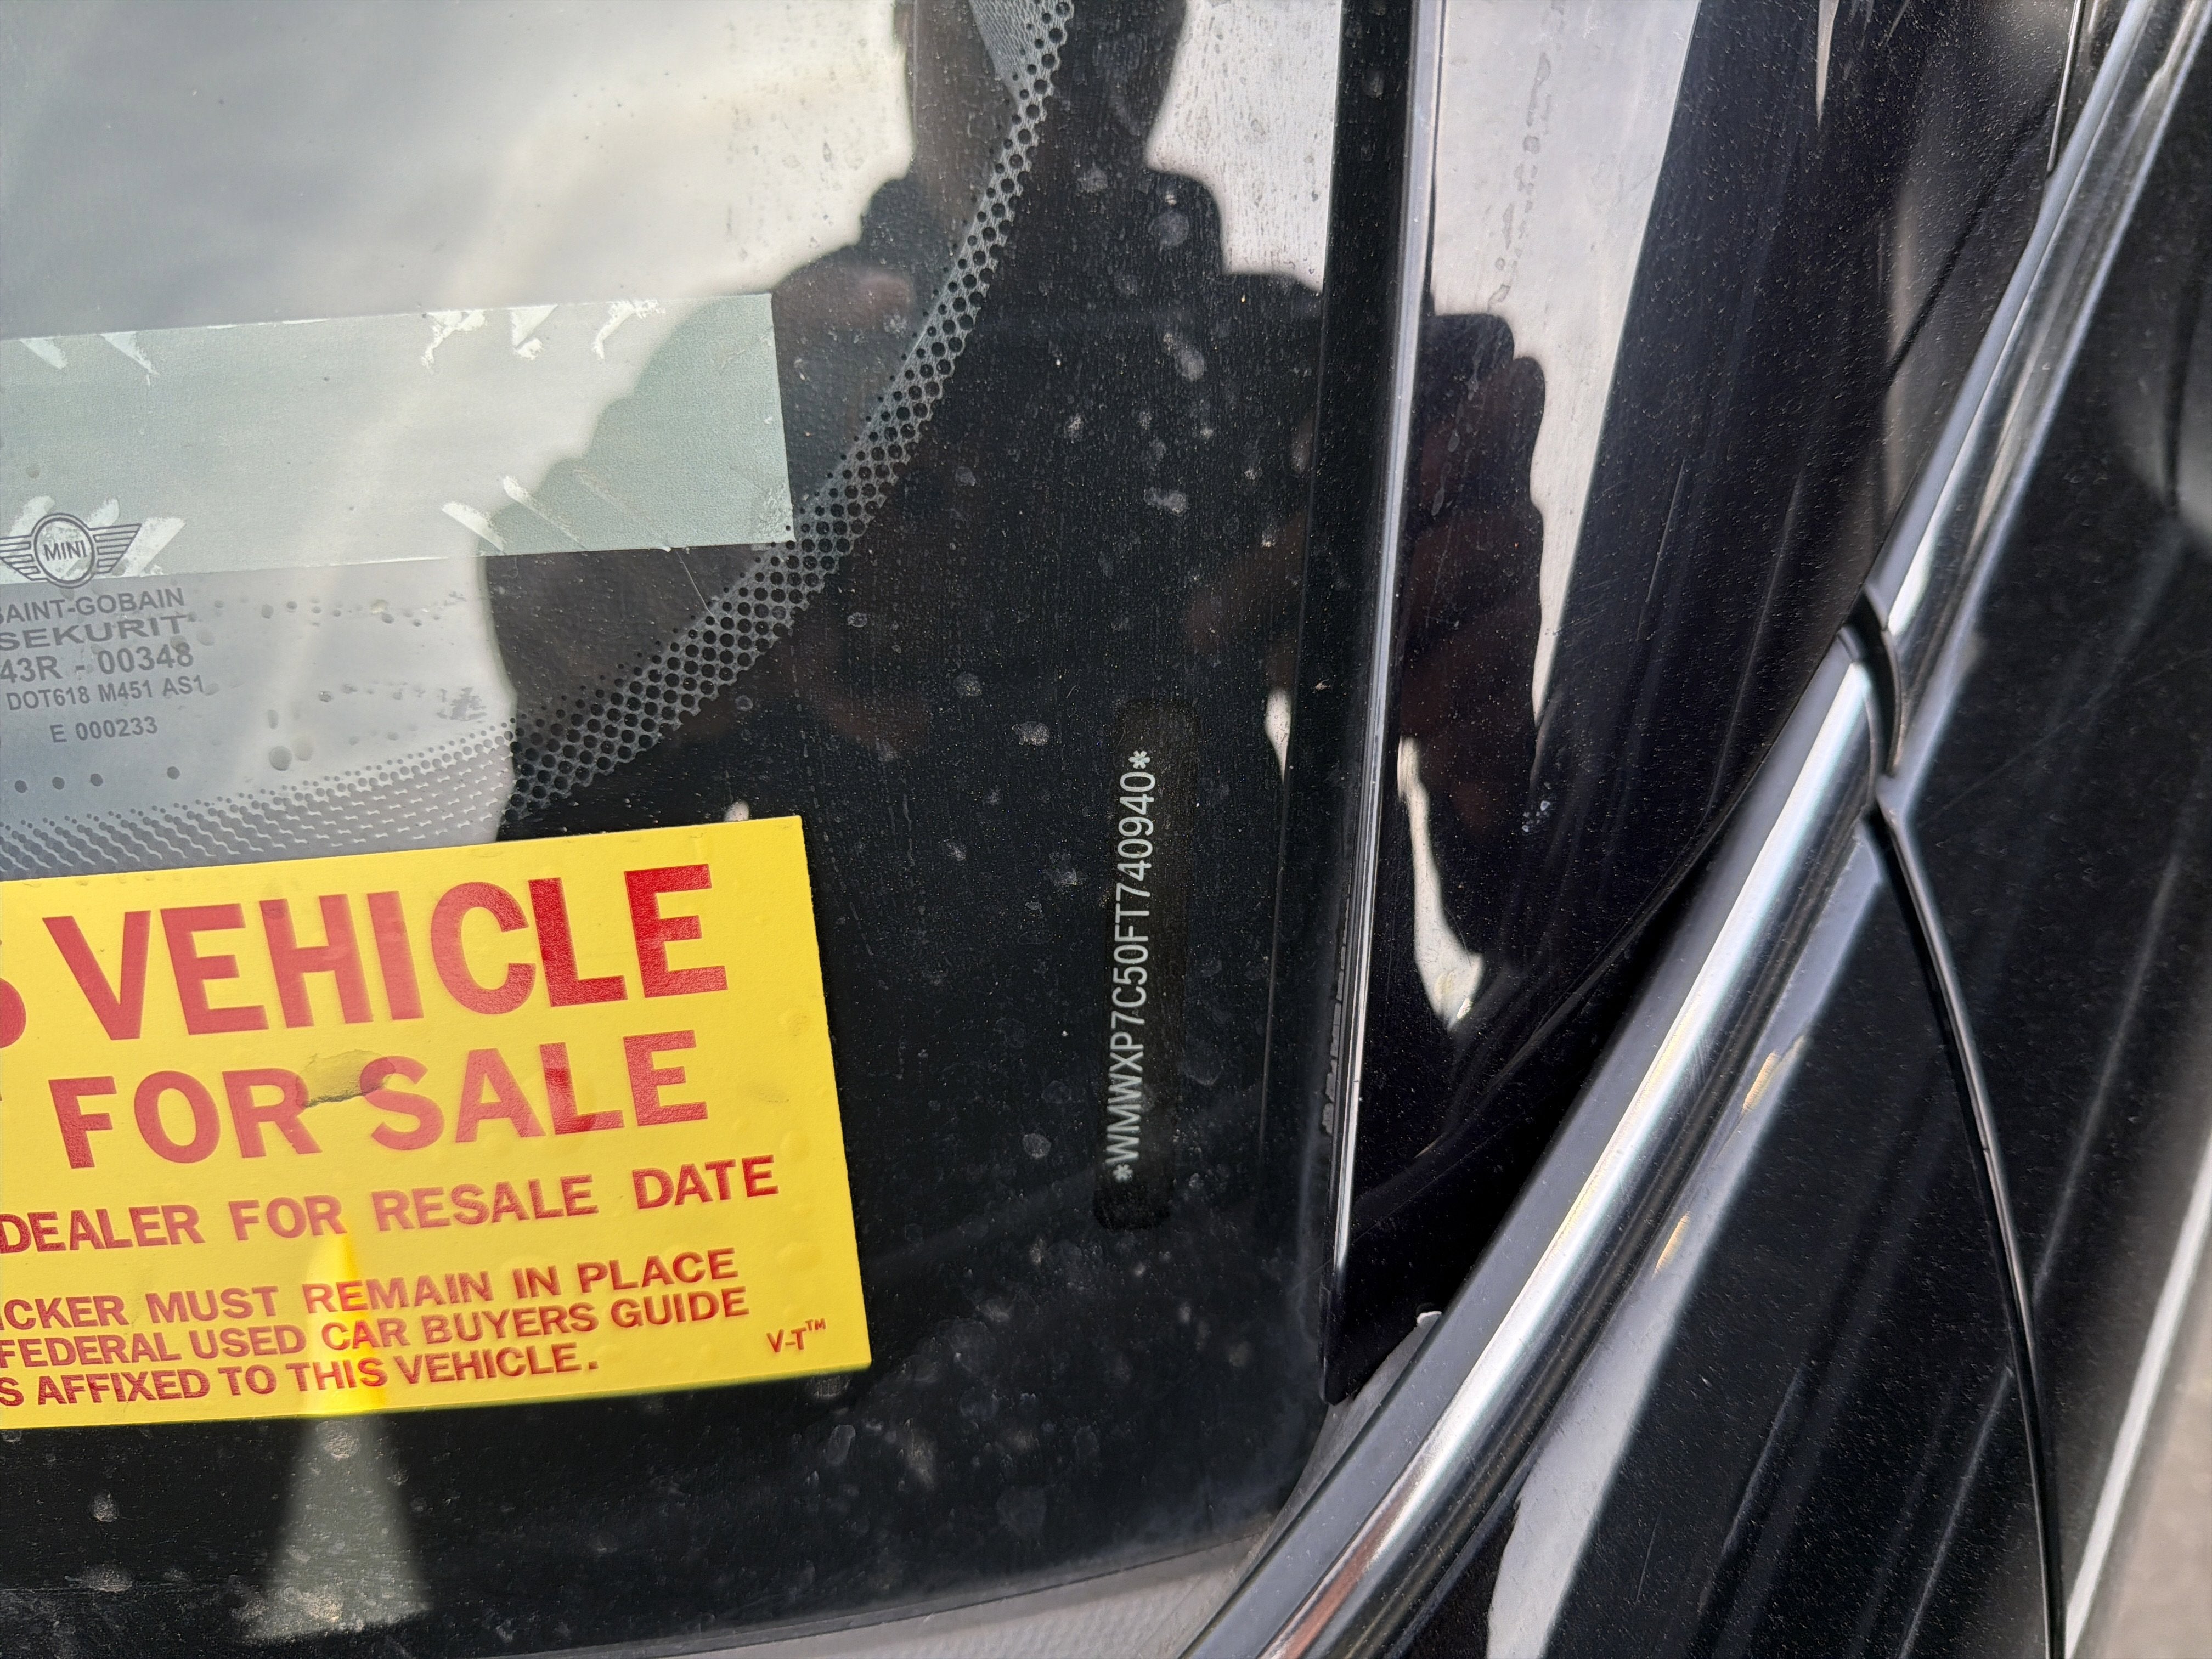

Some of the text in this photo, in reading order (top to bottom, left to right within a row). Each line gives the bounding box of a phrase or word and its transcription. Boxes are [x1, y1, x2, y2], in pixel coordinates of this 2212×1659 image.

[43, 540, 87, 561] MINI
[0, 588, 184, 624] AINT-GOBAIN
[0, 614, 187, 651] SEKURIT
[0, 656, 63, 684] 43R
[98, 642, 194, 674] 00348
[7, 675, 204, 710] DOT618 M451 AS1
[50, 716, 157, 743] E 000233
[42, 864, 728, 1040] VEHICLE
[48, 1030, 708, 1169] FOR SALE
[0, 1155, 779, 1254] DEALER FOR RESALE DATE
[145, 1285, 279, 1324] MUST
[302, 1271, 494, 1313] REMAIN
[512, 1265, 561, 1299] IN
[577, 1248, 739, 1293] PLACE
[0, 1286, 750, 1368] FEDERAL USED CAR BUYERS GUIDE
[37, 1368, 211, 1406] AFFIXED
[218, 1364, 278, 1396] TO
[285, 1357, 388, 1392] THIS
[394, 1342, 599, 1384] VEHICLE.
